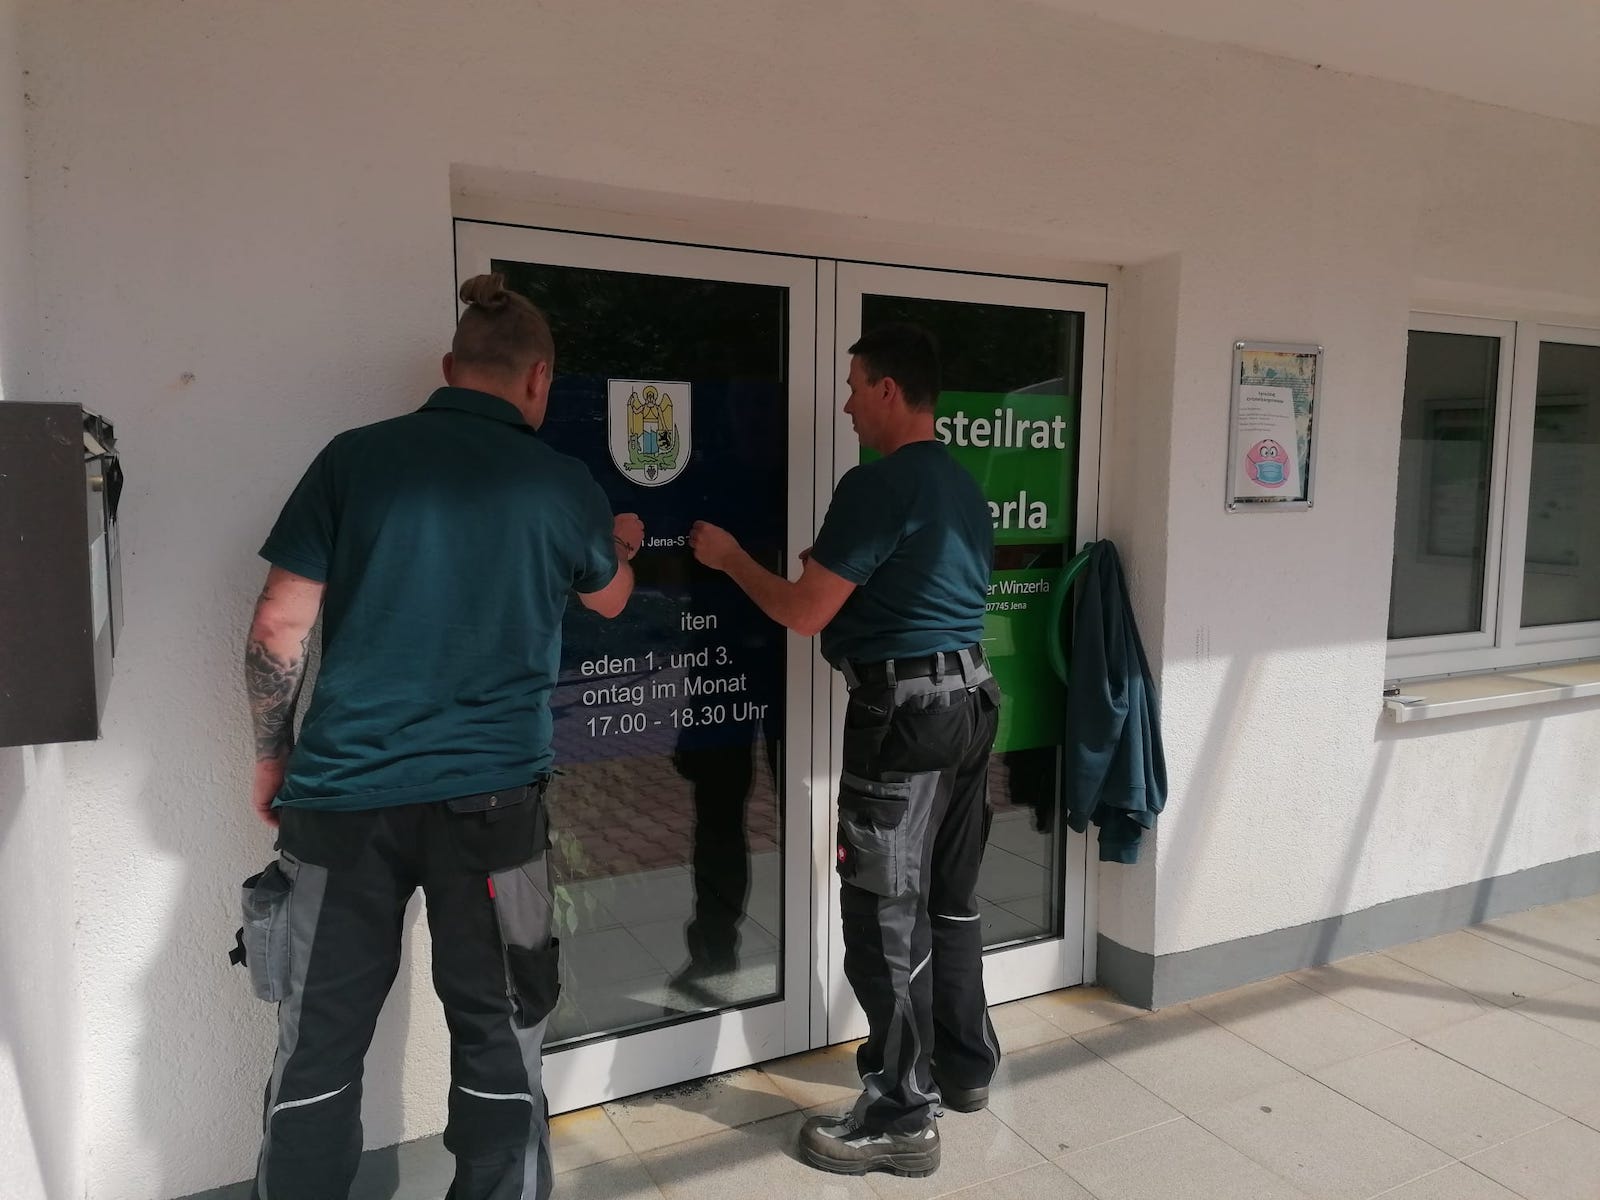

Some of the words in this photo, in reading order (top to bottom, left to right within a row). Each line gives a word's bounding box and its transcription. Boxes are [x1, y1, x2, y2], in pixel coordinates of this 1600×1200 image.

[647, 535, 691, 547] Jena-S
[999, 578, 1050, 595] Winzerla
[985, 601, 1009, 611] 07745
[1010, 601, 1027, 610] Jena
[580, 655, 636, 676] eden
[644, 651, 663, 671] 1.
[670, 648, 708, 669] und
[715, 646, 734, 665] 3.
[582, 684, 644, 706] ontag
[652, 680, 676, 699] im
[684, 673, 747, 696] Monat
[586, 712, 647, 737] 17.00
[670, 704, 726, 729] 18.30
[732, 702, 769, 722] Uhr
